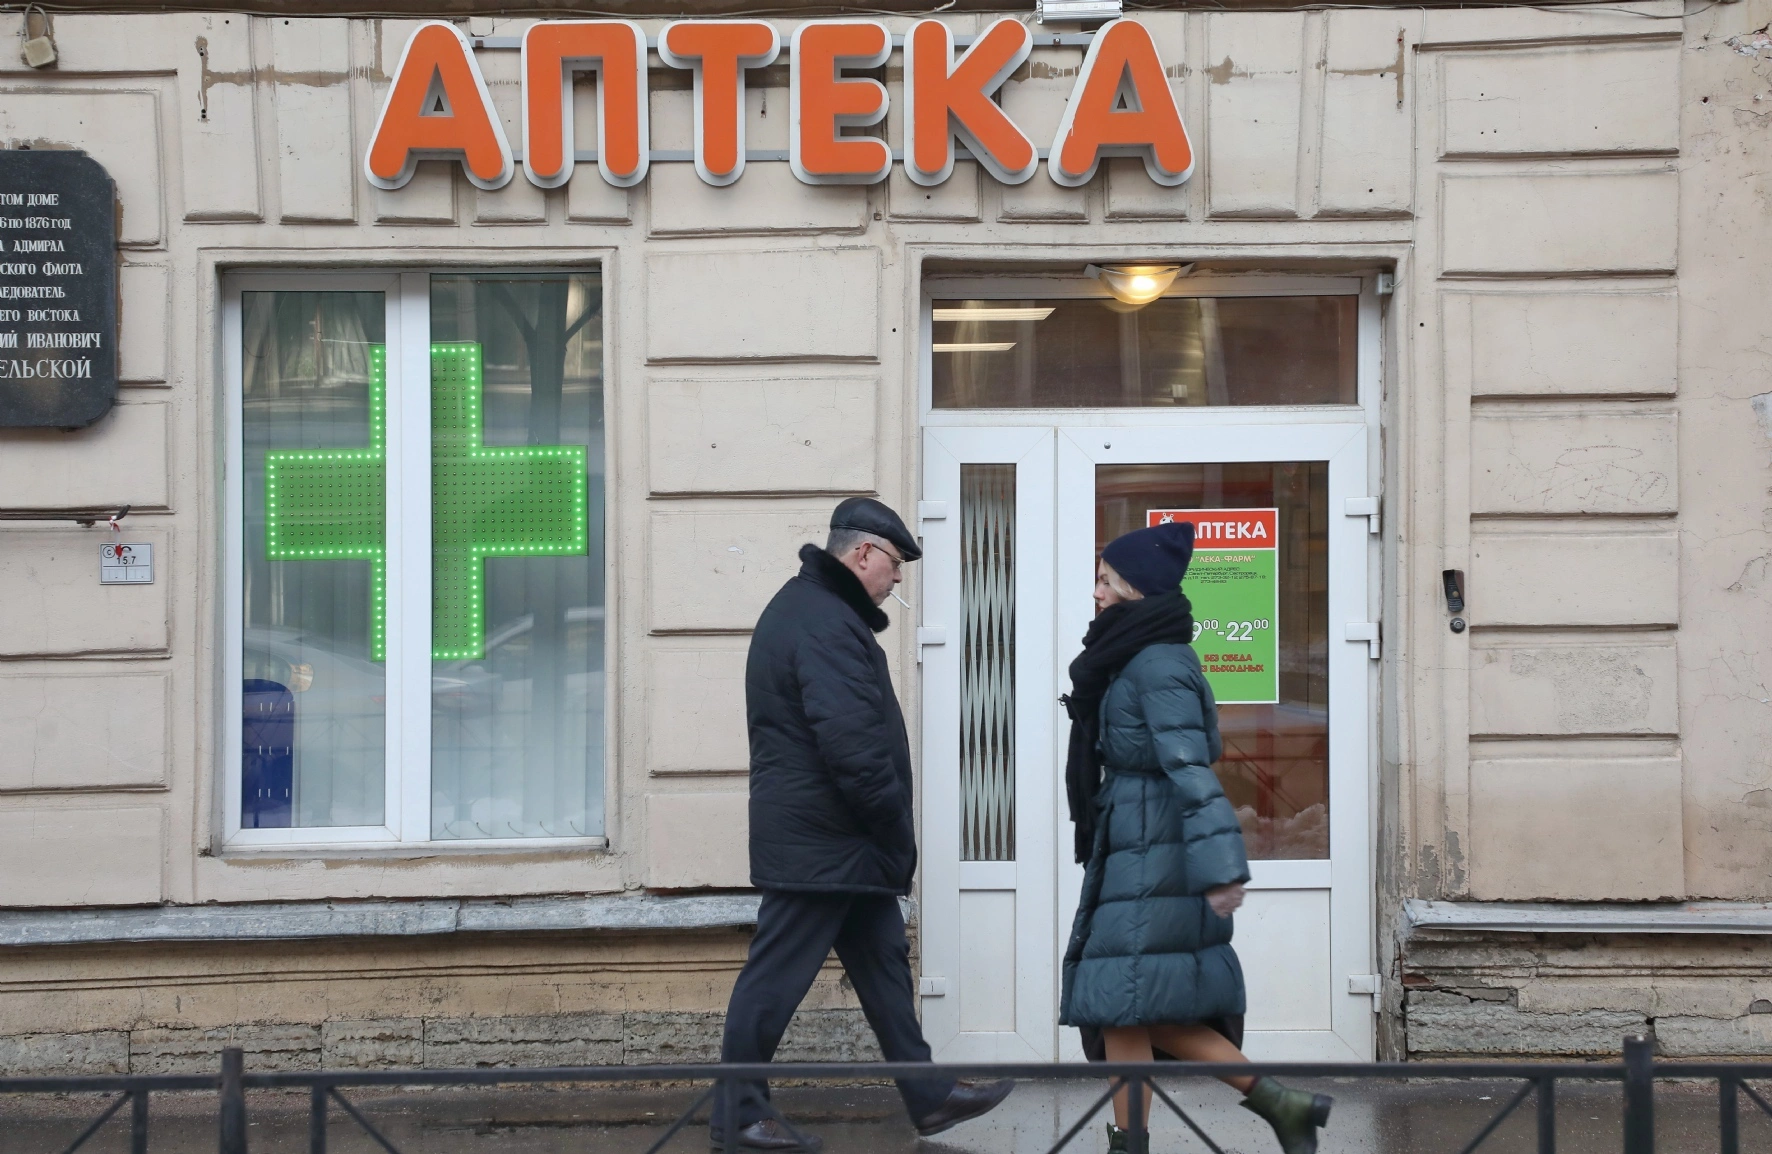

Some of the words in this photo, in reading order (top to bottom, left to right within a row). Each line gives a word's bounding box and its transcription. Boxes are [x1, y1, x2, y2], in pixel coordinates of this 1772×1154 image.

[365, 18, 1196, 188] АПТЕКА
[27, 193, 59, 207] ДОМЕ
[24, 217, 50, 229] 1876
[13, 240, 65, 254] АДМИРАЛ
[42, 261, 83, 276] ФЛОТА
[26, 308, 81, 322] ВОСТОКА
[26, 332, 101, 348] ИВАНОВИЧ
[1195, 520, 1267, 539] ПТЕКА
[1204, 654, 1219, 662] БЕЗ
[1221, 653, 1253, 662] ОБЕДА
[1210, 664, 1264, 673] ВЫХОДНЫХ
